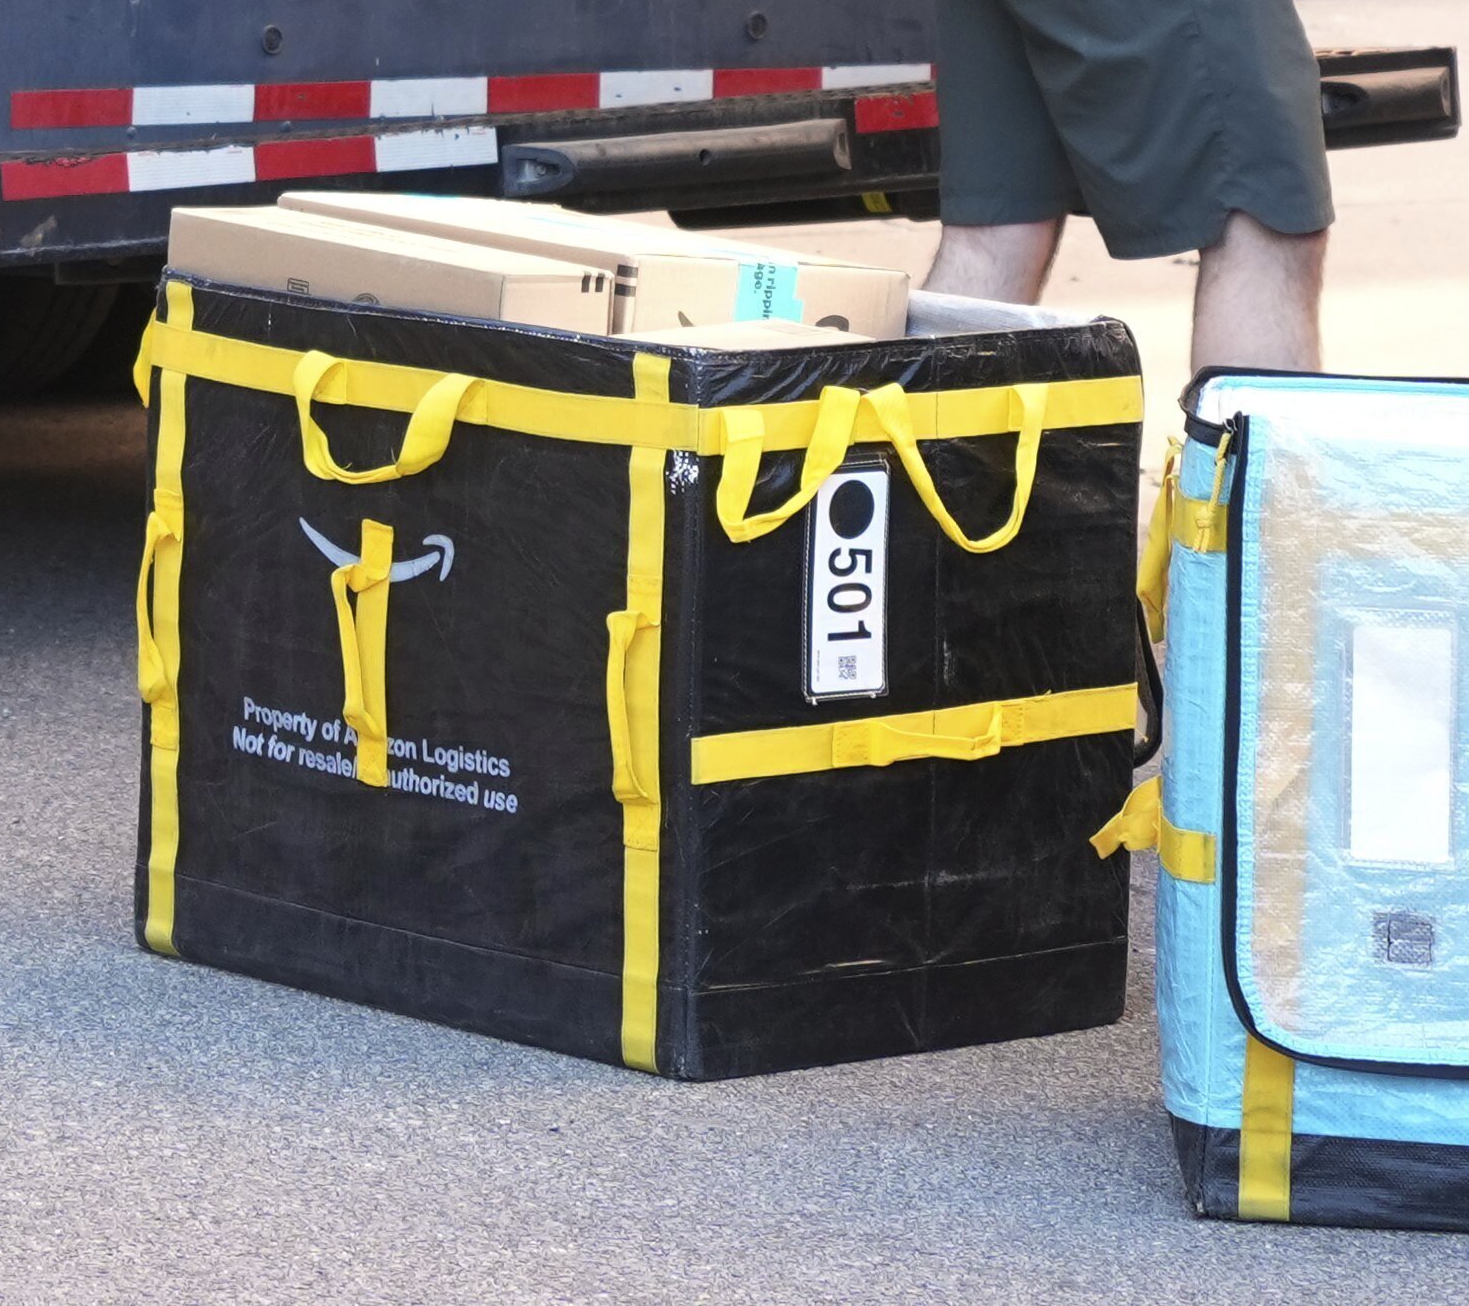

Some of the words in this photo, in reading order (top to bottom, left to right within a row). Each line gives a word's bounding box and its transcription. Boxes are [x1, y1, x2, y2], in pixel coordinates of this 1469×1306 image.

[826, 546, 873, 643] 501
[232, 725, 266, 756] Not
[267, 734, 296, 763] for
[483, 787, 519, 814] use
[243, 696, 318, 742] Property
[321, 718, 342, 743] of
[344, 725, 417, 760] Azon
[422, 738, 511, 778] Logistics
